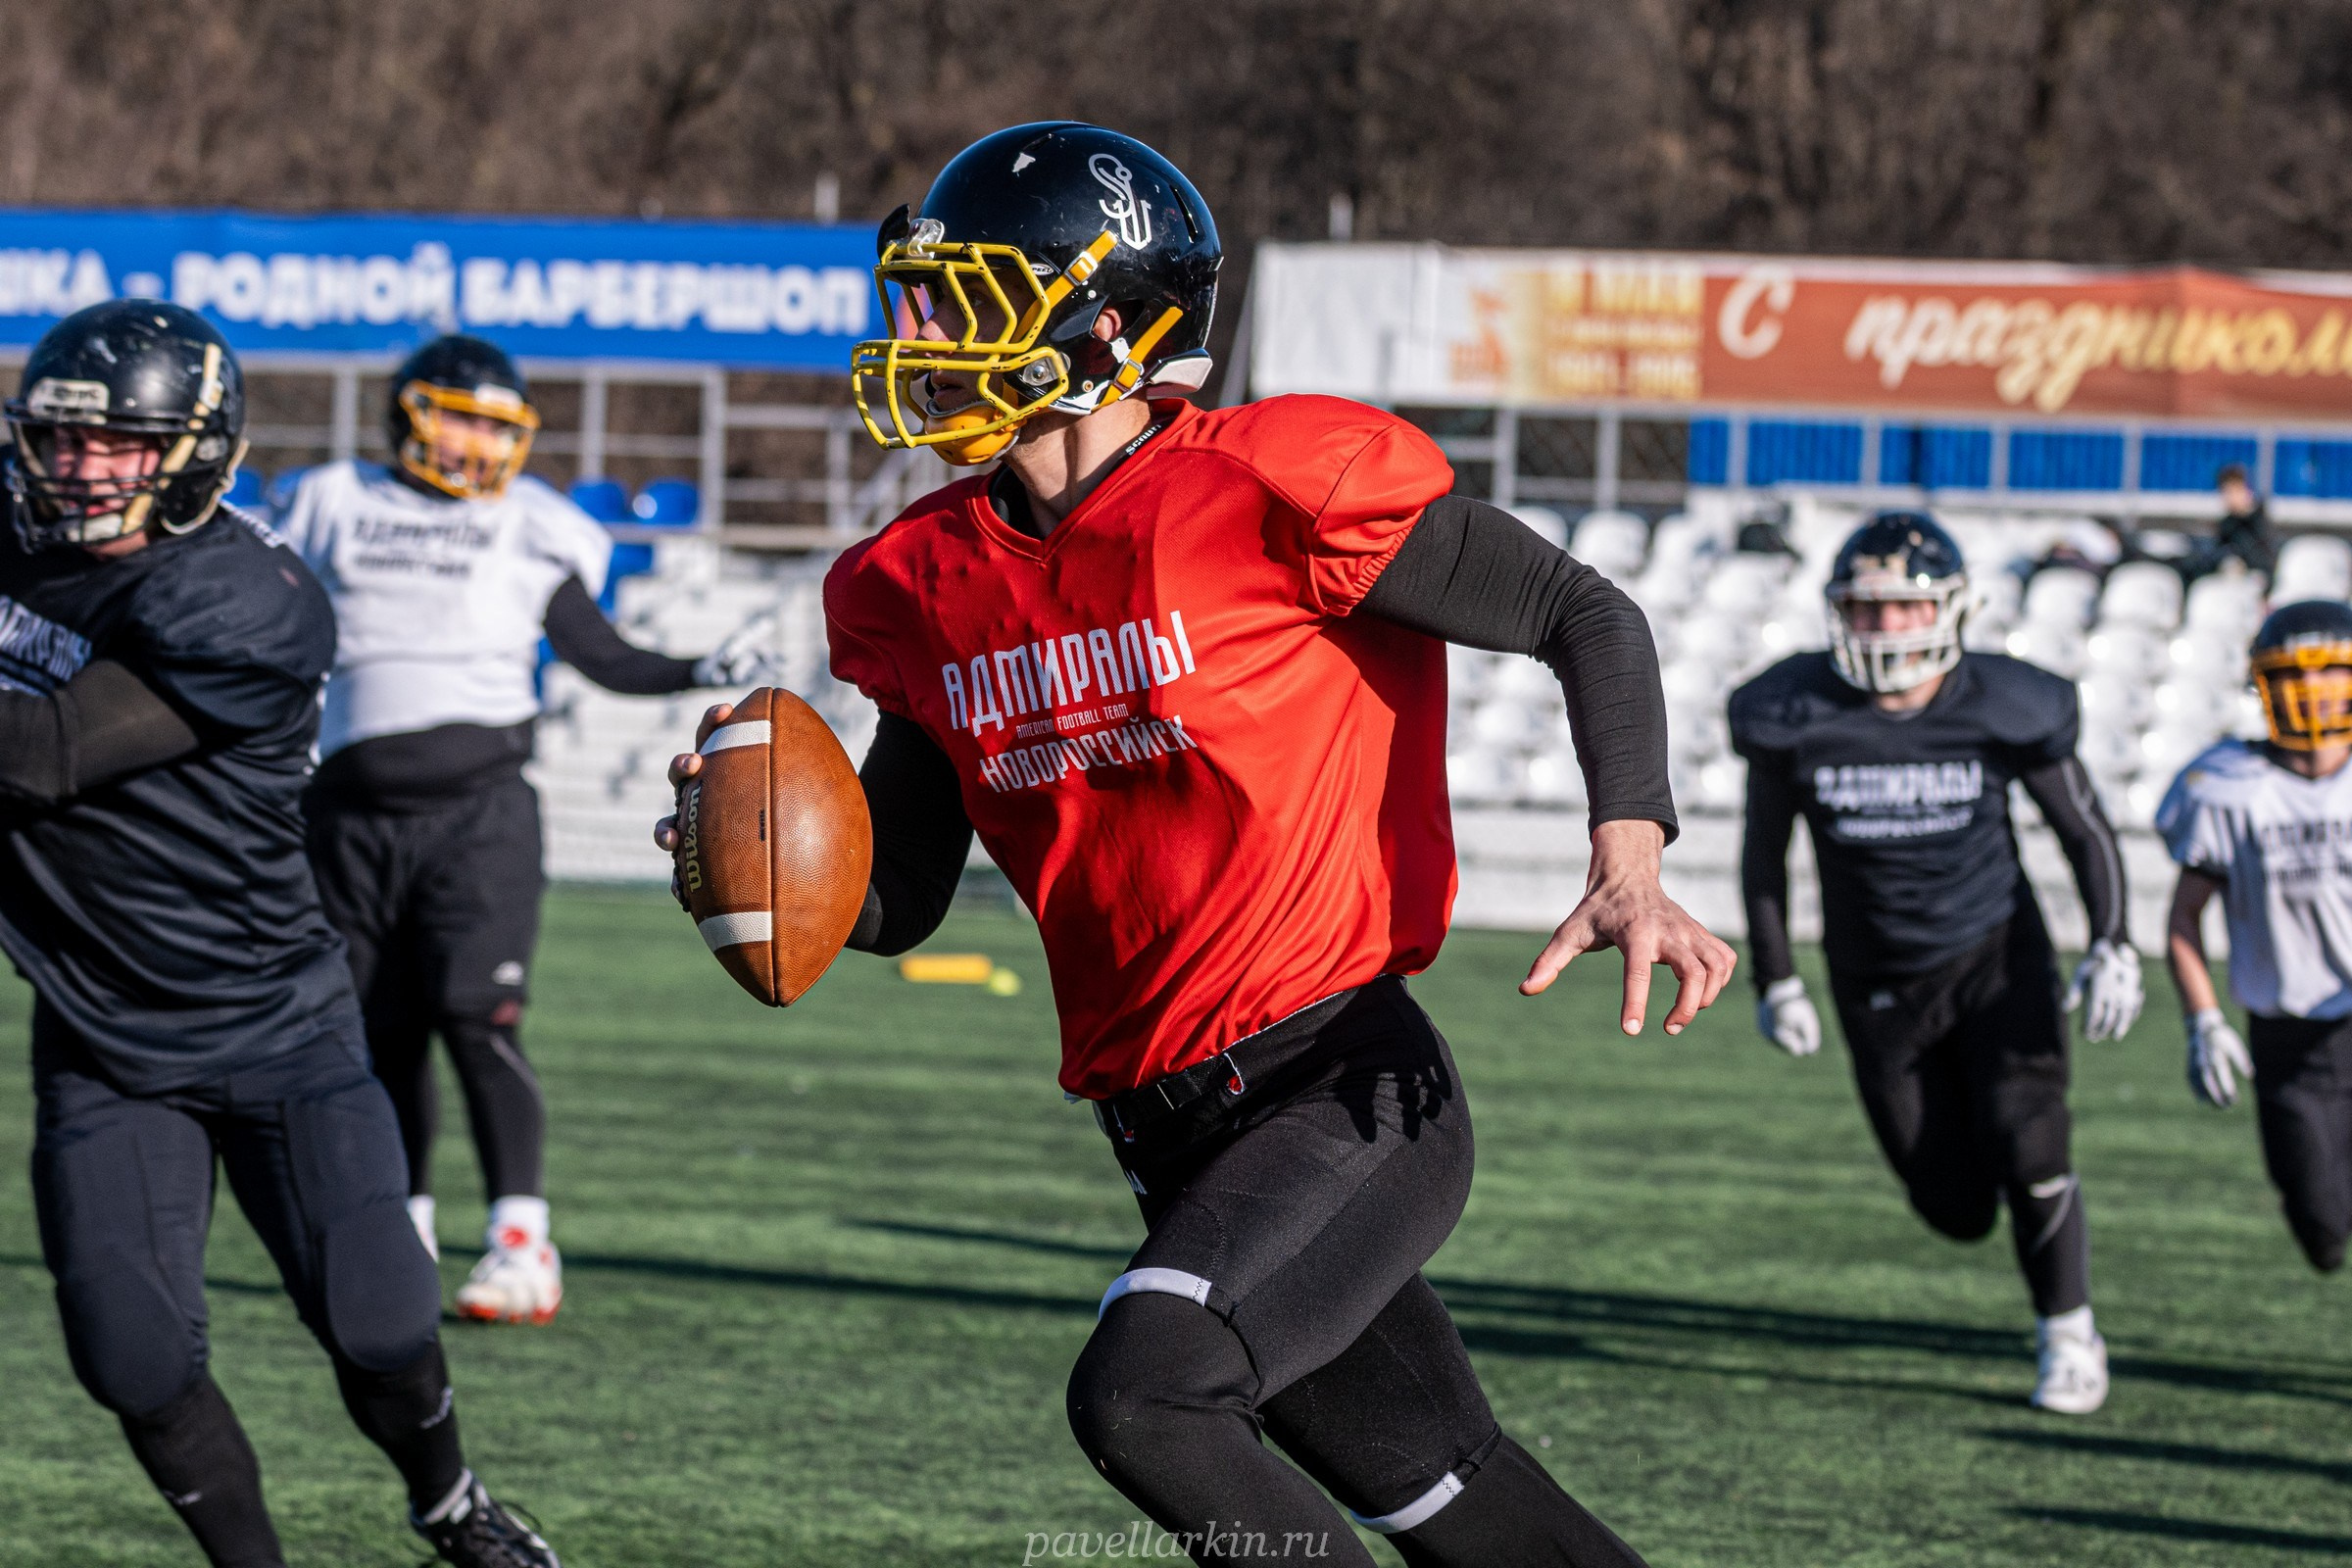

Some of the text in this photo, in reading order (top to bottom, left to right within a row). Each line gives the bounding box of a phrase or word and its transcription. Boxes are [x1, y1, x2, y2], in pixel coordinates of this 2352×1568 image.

[172, 241, 457, 329] РОДНОЙ
[462, 257, 869, 336] БАРБЕРШОП
[1718, 263, 1795, 360] С
[942, 610, 1196, 737] АДМИРАЛЫ
[1016, 703, 1129, 739] AMERICAN FOOTBALL TEAM
[979, 715, 1198, 793] НОВОРОССИЙСК
[684, 786, 703, 893] Wilson
